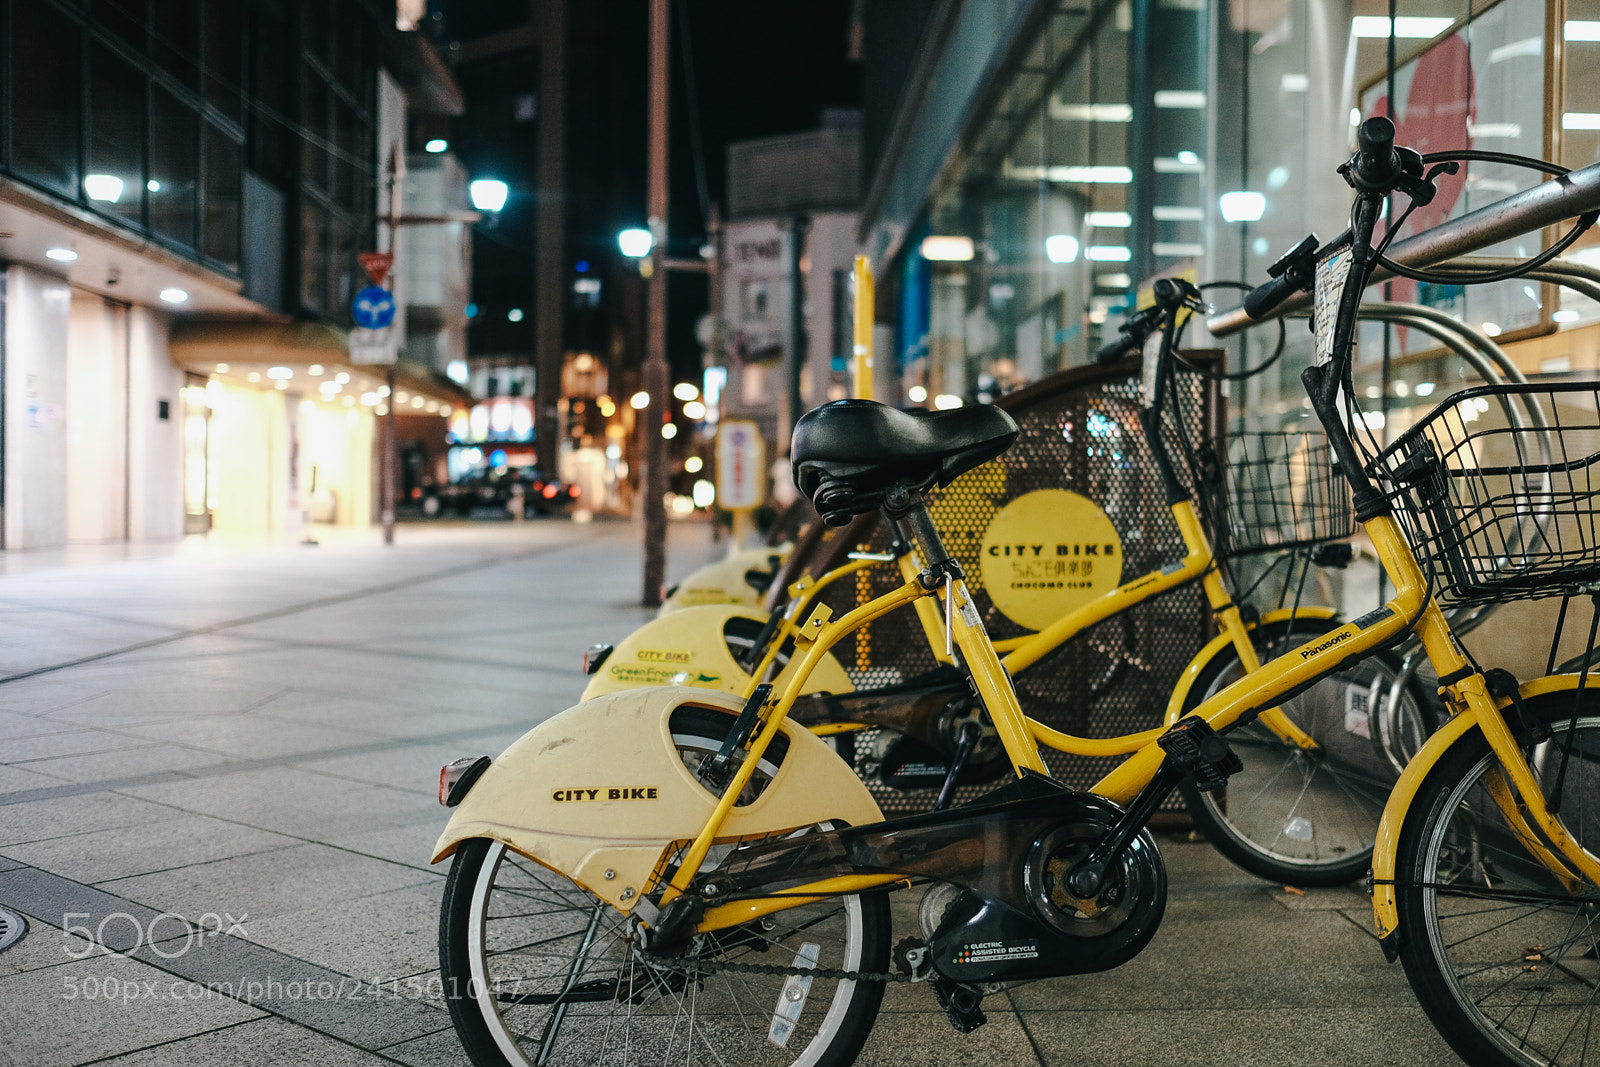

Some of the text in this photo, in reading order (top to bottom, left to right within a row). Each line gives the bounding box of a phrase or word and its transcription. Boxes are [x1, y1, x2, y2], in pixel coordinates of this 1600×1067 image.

[988, 544, 1114, 557] CITY BIKE
[1011, 581, 1093, 590] CHOCOMO CLUB
[1300, 631, 1352, 660] Panasonic
[637, 650, 691, 661] CITY BIKE
[552, 788, 658, 801] CITY BIKE
[970, 941, 1003, 950] ELECTRIC
[971, 945, 1036, 956] ASSISTED BICYCLE
